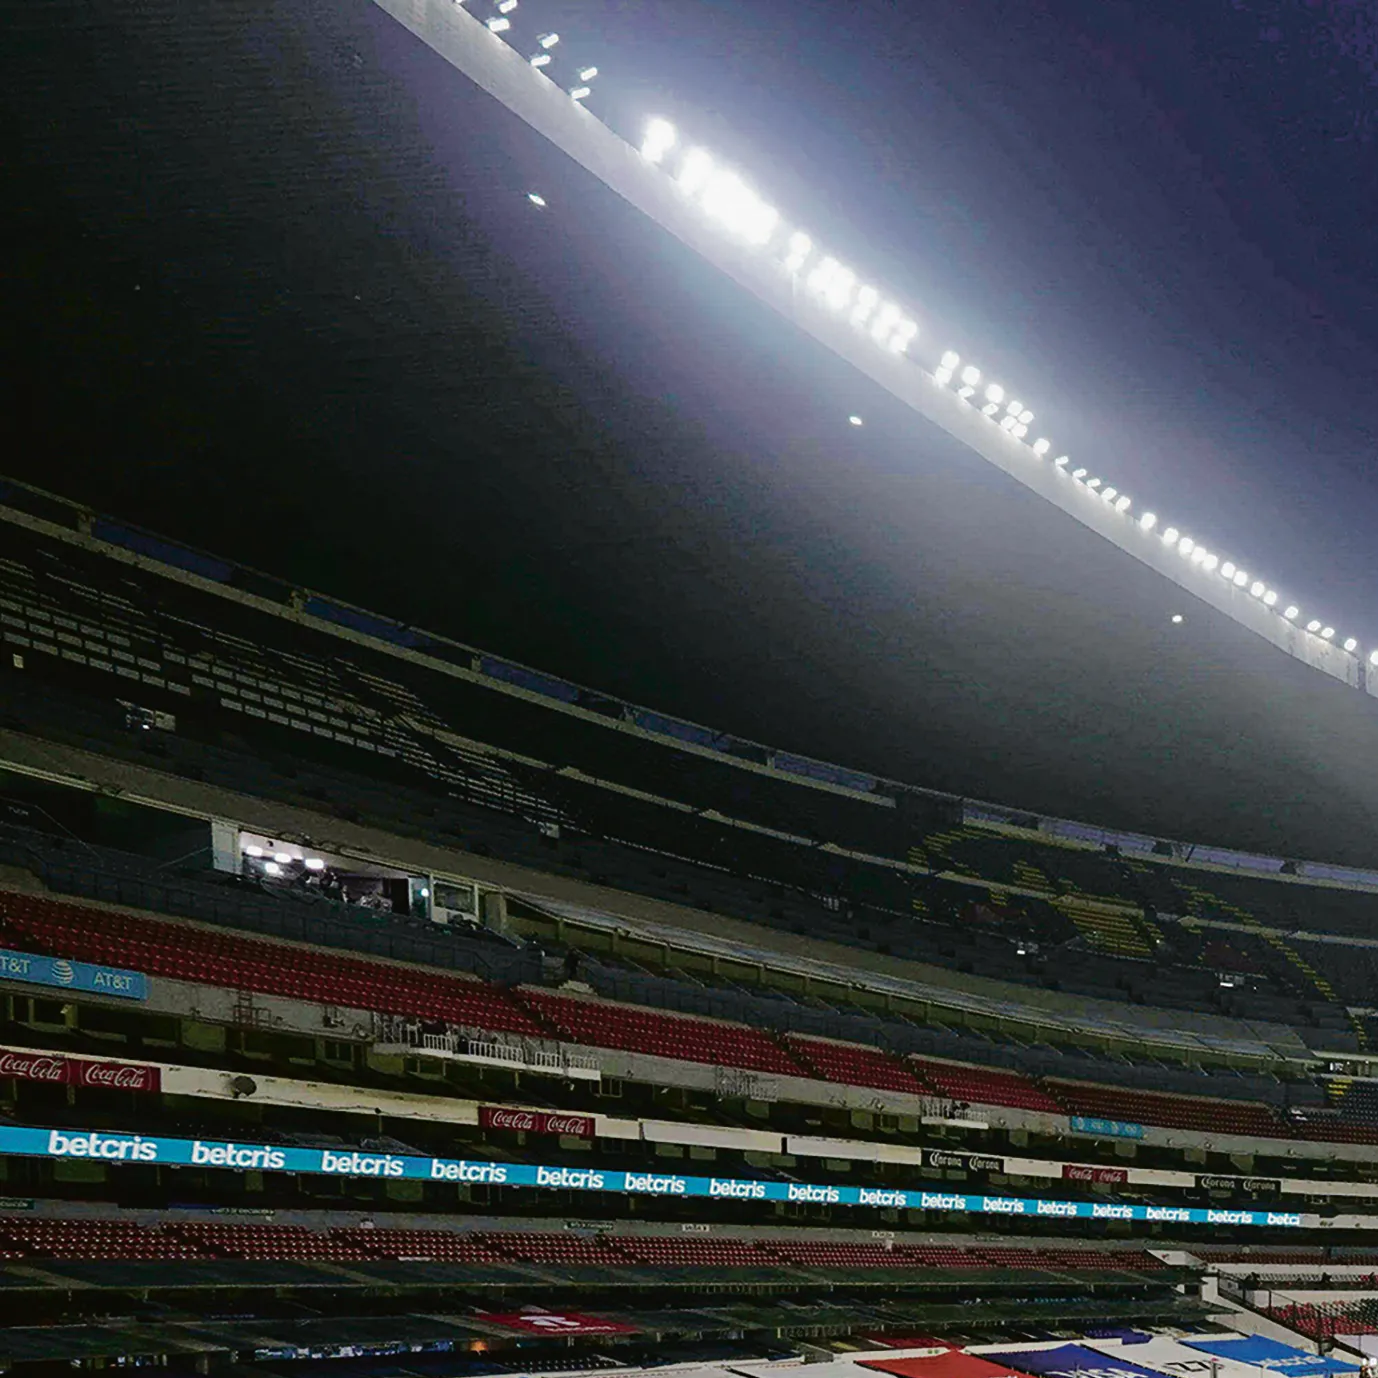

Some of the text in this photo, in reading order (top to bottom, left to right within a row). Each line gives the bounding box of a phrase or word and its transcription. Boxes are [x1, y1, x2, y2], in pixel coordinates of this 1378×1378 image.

[0, 956, 134, 990] T&T AT&T
[0, 1054, 146, 1088] Coca-Cola Coca-Cola
[492, 1110, 587, 1134] Coca-Cola Coca-Cola
[48, 1129, 158, 1161] betcris
[191, 1140, 286, 1169] betcris
[321, 1151, 404, 1177] betcris
[430, 1158, 507, 1183] betcris
[536, 1166, 604, 1189] betcris
[624, 1172, 685, 1194] betcris
[709, 1178, 765, 1199] betcris
[788, 1183, 839, 1202] betcris
[859, 1188, 906, 1206] betcris
[921, 1192, 966, 1210] betcris
